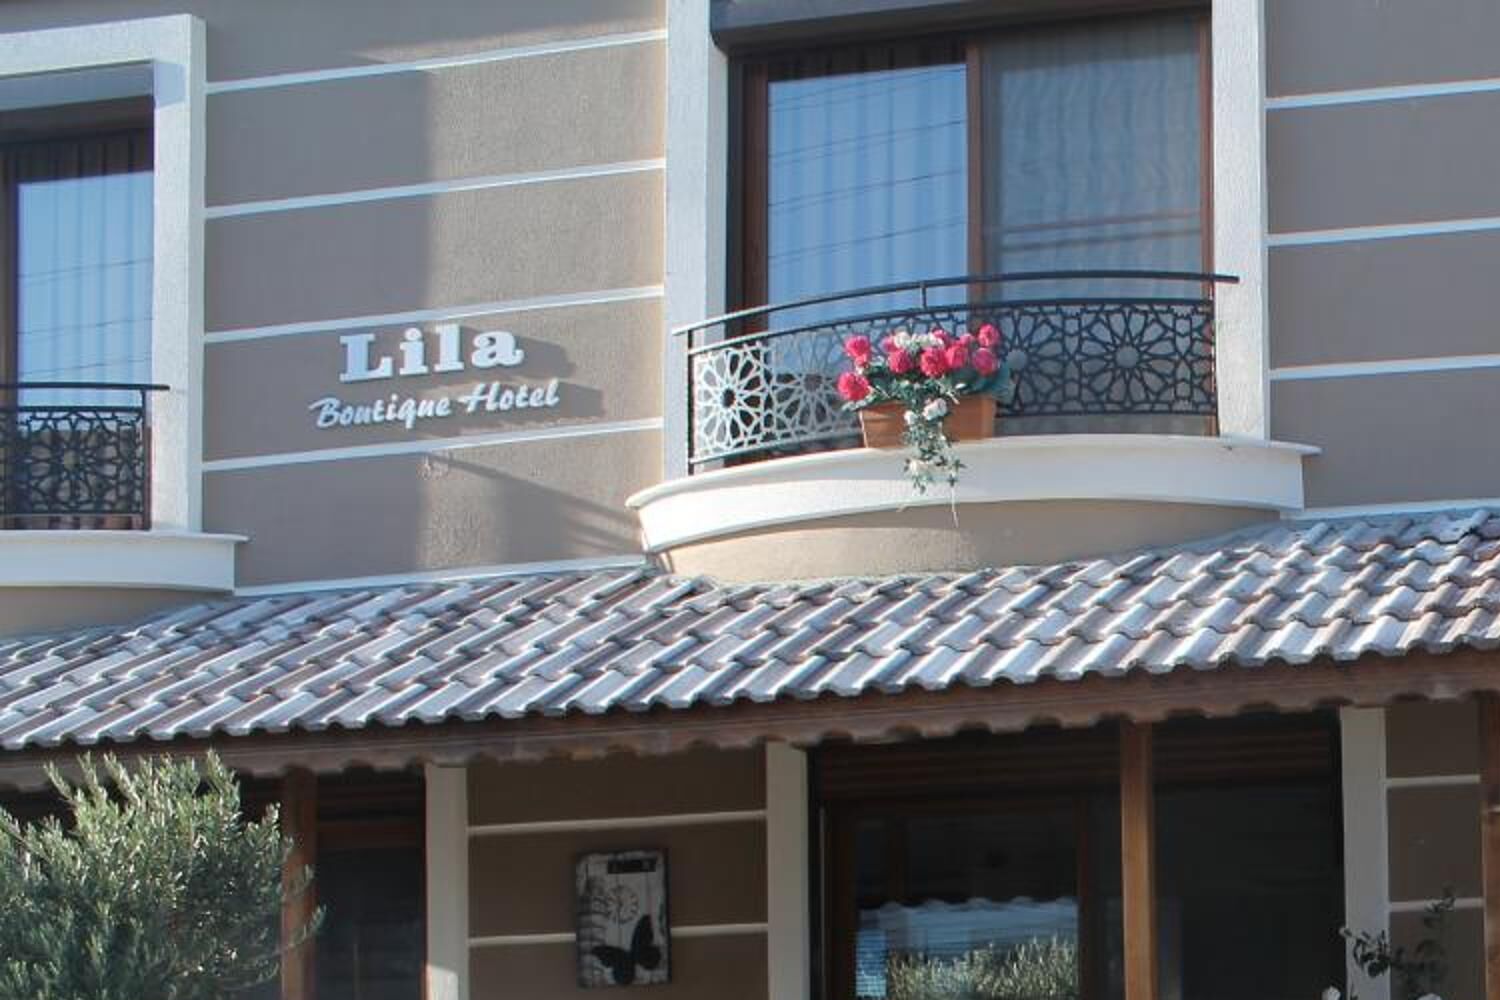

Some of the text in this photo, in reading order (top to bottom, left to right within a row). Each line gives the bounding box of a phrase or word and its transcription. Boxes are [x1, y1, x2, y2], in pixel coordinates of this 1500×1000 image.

[339, 323, 524, 383] Lila
[309, 378, 560, 429] Boutique Hotel
